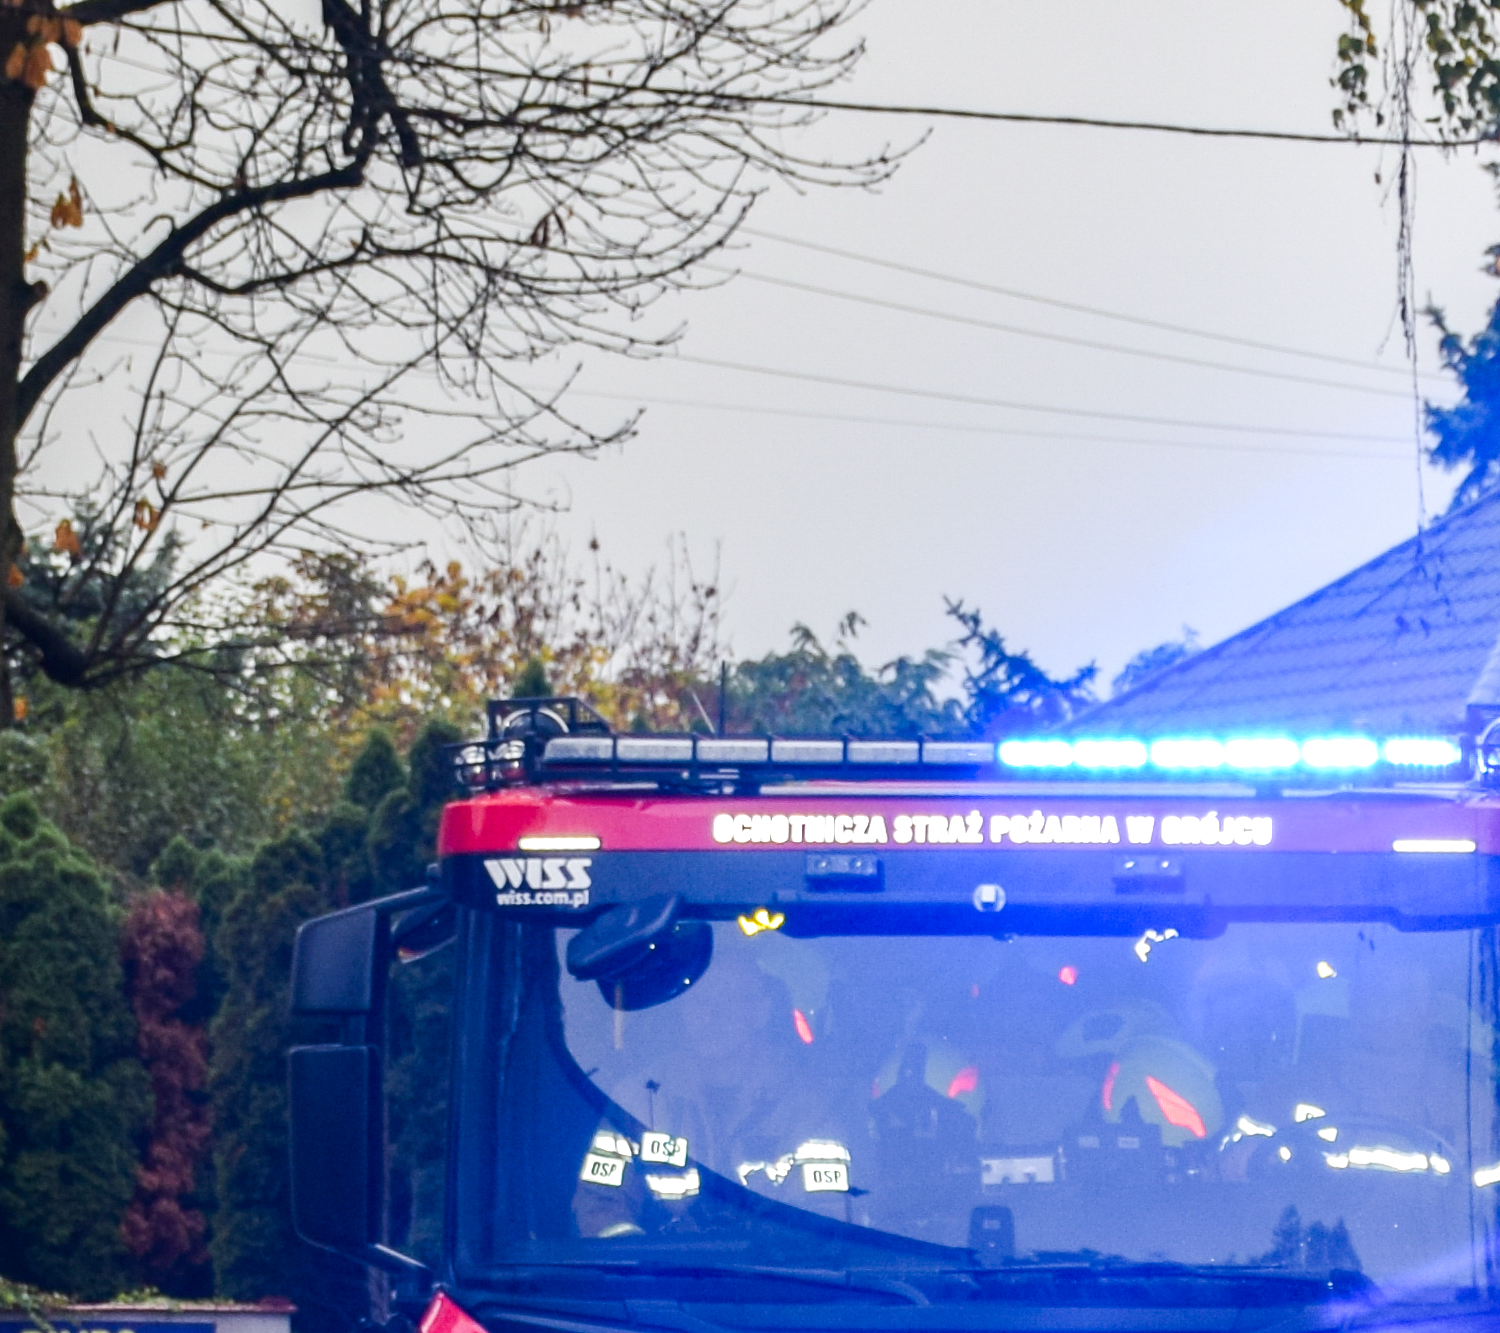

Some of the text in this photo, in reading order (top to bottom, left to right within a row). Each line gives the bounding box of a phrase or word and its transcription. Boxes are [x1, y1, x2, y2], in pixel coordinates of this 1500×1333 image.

[713, 810, 1273, 845] OCHOTNICZA STRAŻ POŻARNA W GRÓJCU
[483, 858, 593, 889] WISS
[497, 891, 589, 908] wiss.com.pl
[651, 1140, 681, 1157] OSP
[591, 1161, 617, 1178] OSP
[813, 1170, 842, 1184] OSP
